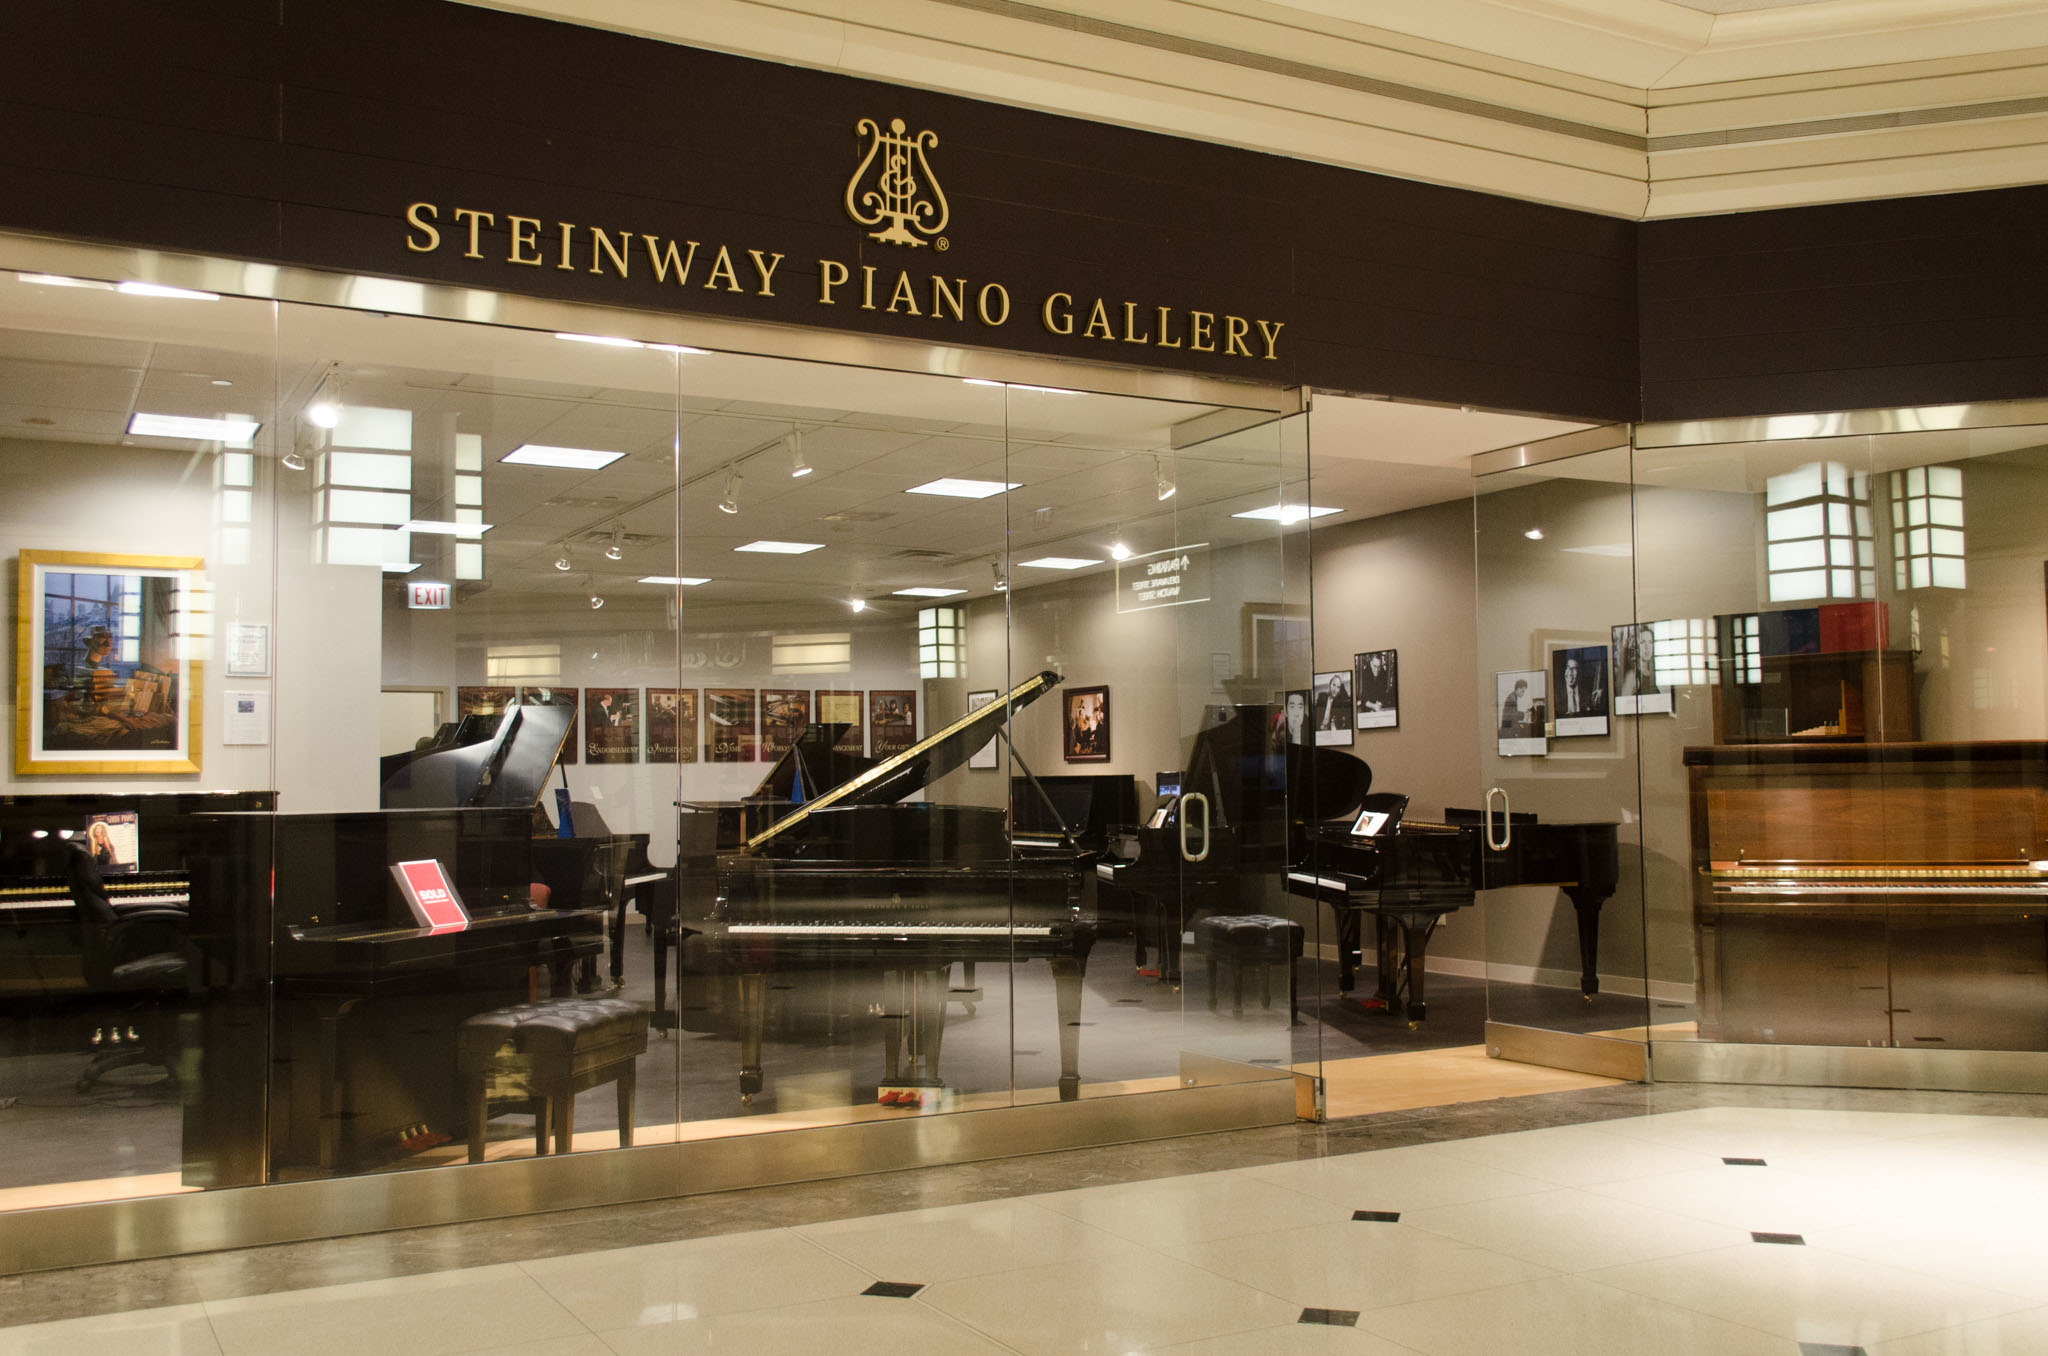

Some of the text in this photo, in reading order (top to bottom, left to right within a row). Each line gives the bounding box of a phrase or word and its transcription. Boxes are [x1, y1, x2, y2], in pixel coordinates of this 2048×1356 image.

[405, 202, 1285, 360] STEINWAY PIANO GALLERY
[415, 587, 446, 605] EXIT
[418, 888, 446, 900] SOLD
